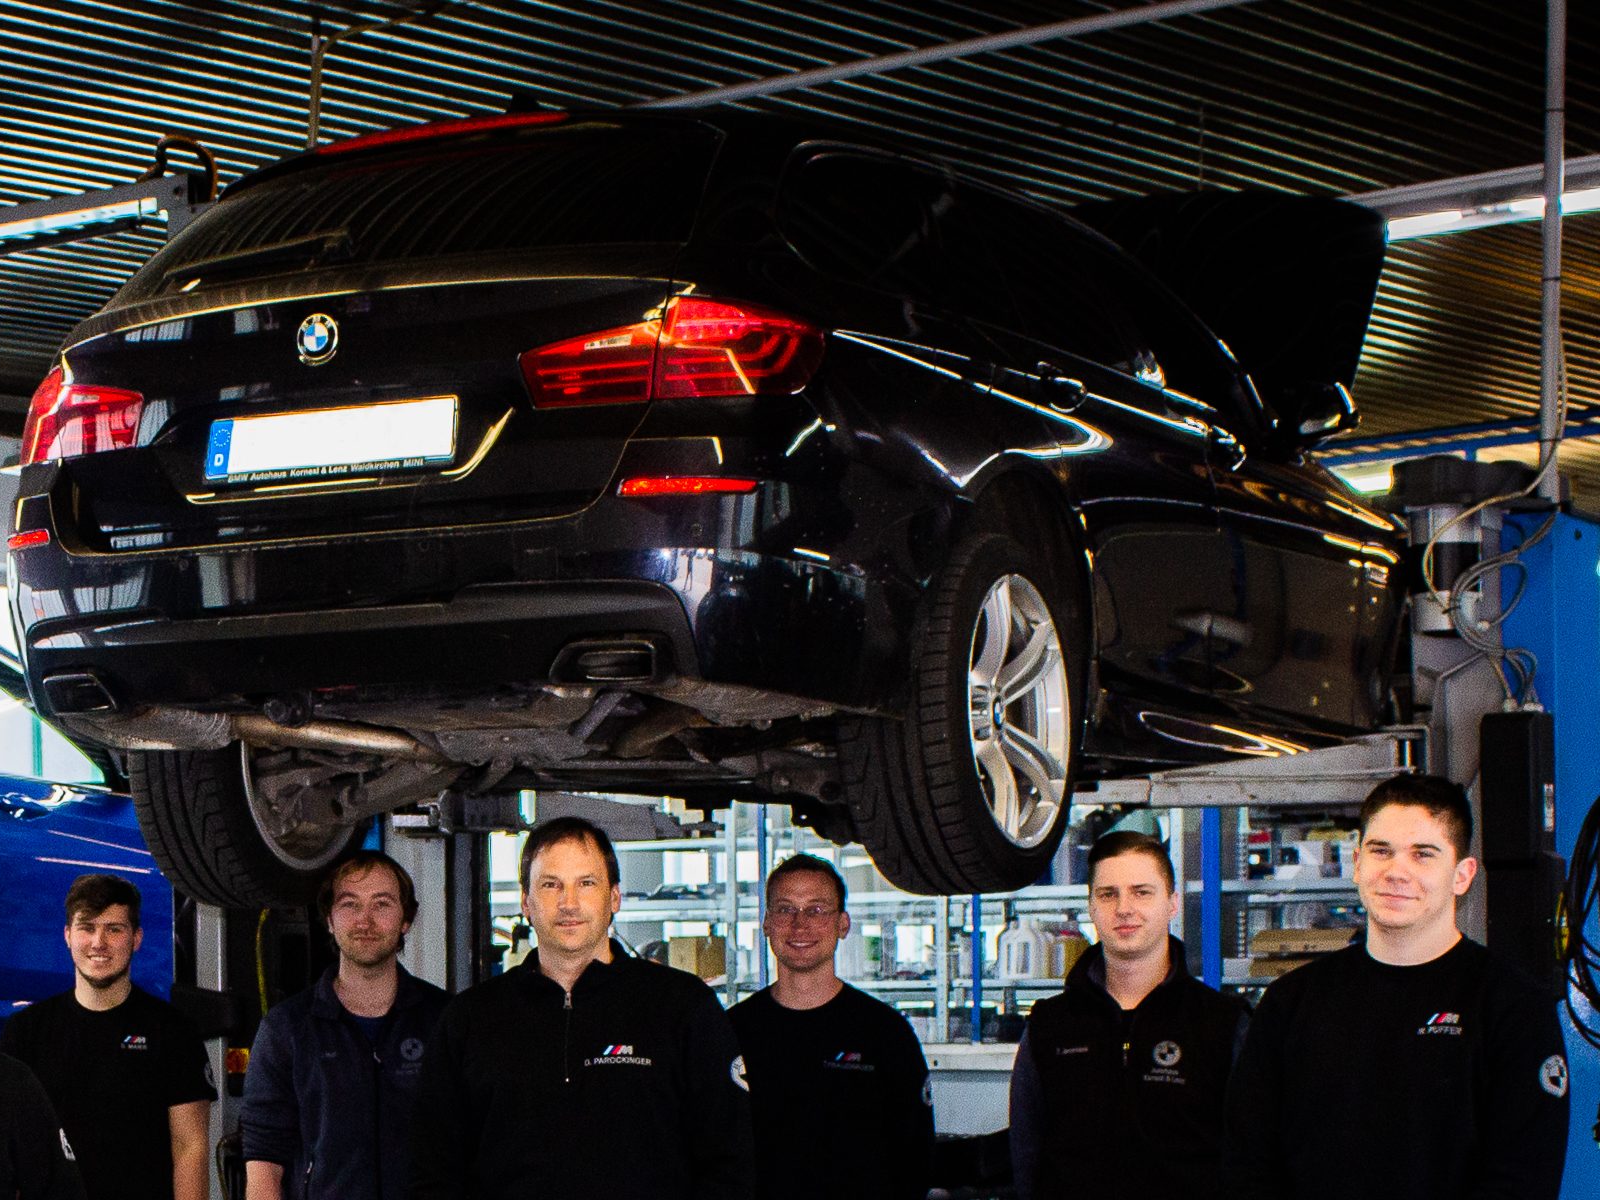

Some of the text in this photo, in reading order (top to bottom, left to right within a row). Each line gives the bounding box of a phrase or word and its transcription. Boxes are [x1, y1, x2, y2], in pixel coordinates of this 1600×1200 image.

[214, 453, 224, 467] D
[228, 473, 248, 483] BMW
[250, 470, 287, 481] Autohaus
[329, 464, 348, 474] Lenz
[351, 460, 400, 472] Waldkirchen
[403, 457, 424, 467] MINI
